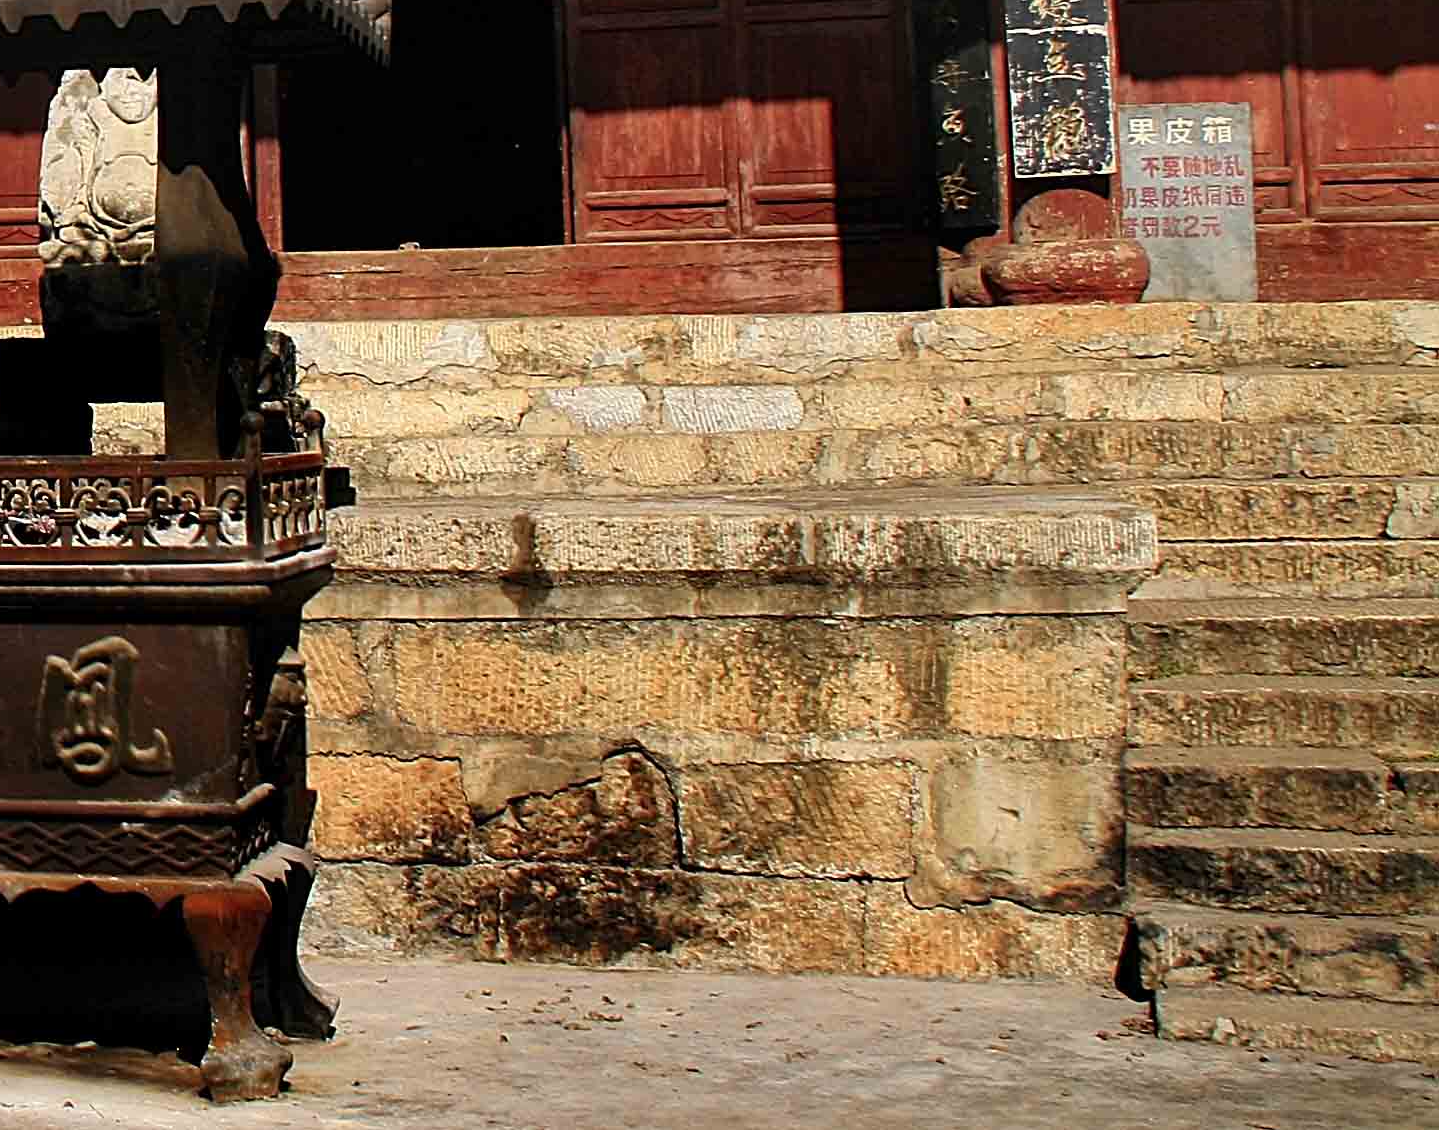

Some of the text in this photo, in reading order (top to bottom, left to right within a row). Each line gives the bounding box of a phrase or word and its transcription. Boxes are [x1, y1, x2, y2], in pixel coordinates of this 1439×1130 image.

[1128, 116, 1233, 145] 果皮箱
[1140, 154, 1246, 179] 不要随地乱
[1122, 215, 1223, 239] 者罚款2元
